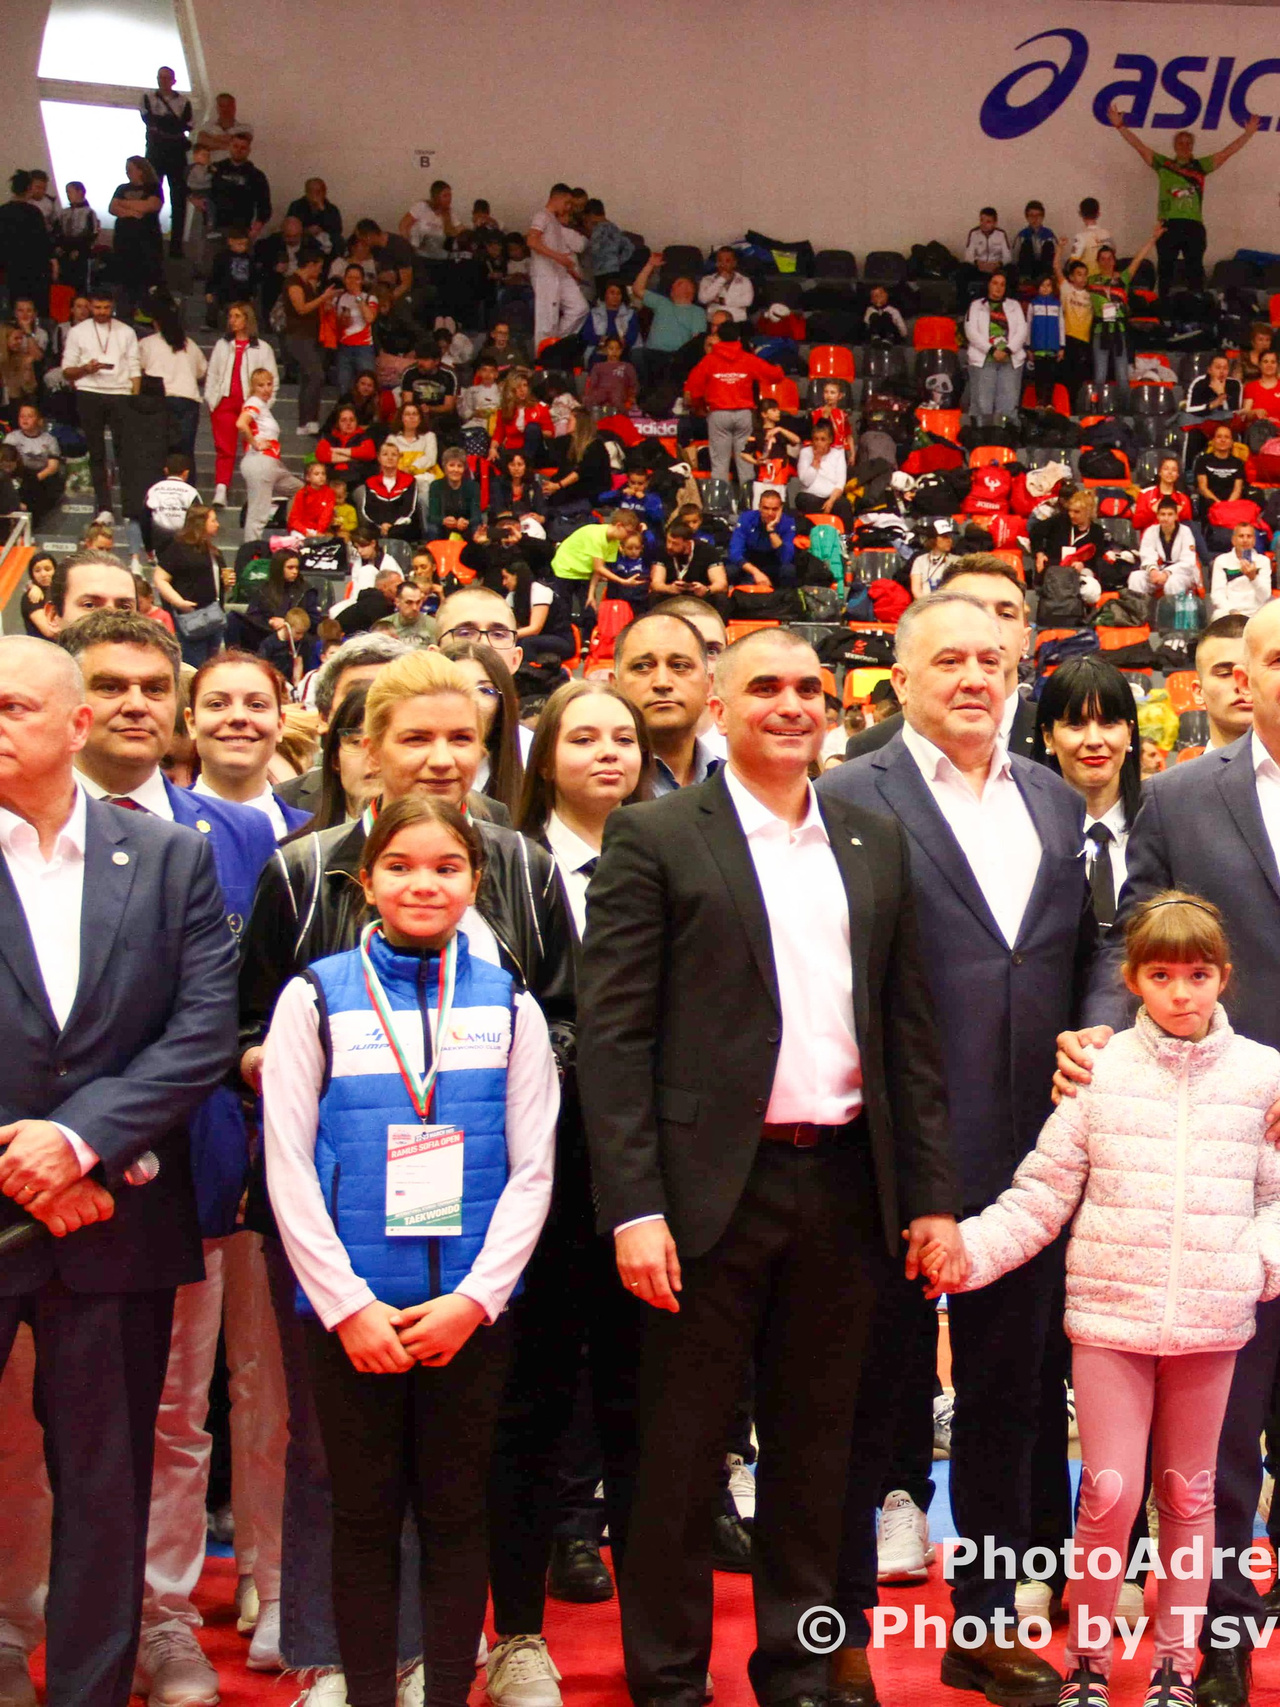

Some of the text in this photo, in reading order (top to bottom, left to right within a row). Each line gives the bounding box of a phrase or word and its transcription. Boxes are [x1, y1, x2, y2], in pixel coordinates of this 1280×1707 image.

[634, 422, 678, 435] adida
[391, 1145, 418, 1159] RAMUS
[418, 1139, 440, 1152] SOFIA
[440, 1133, 460, 1147] OPEN
[404, 1203, 460, 1226] TAEKWONDO
